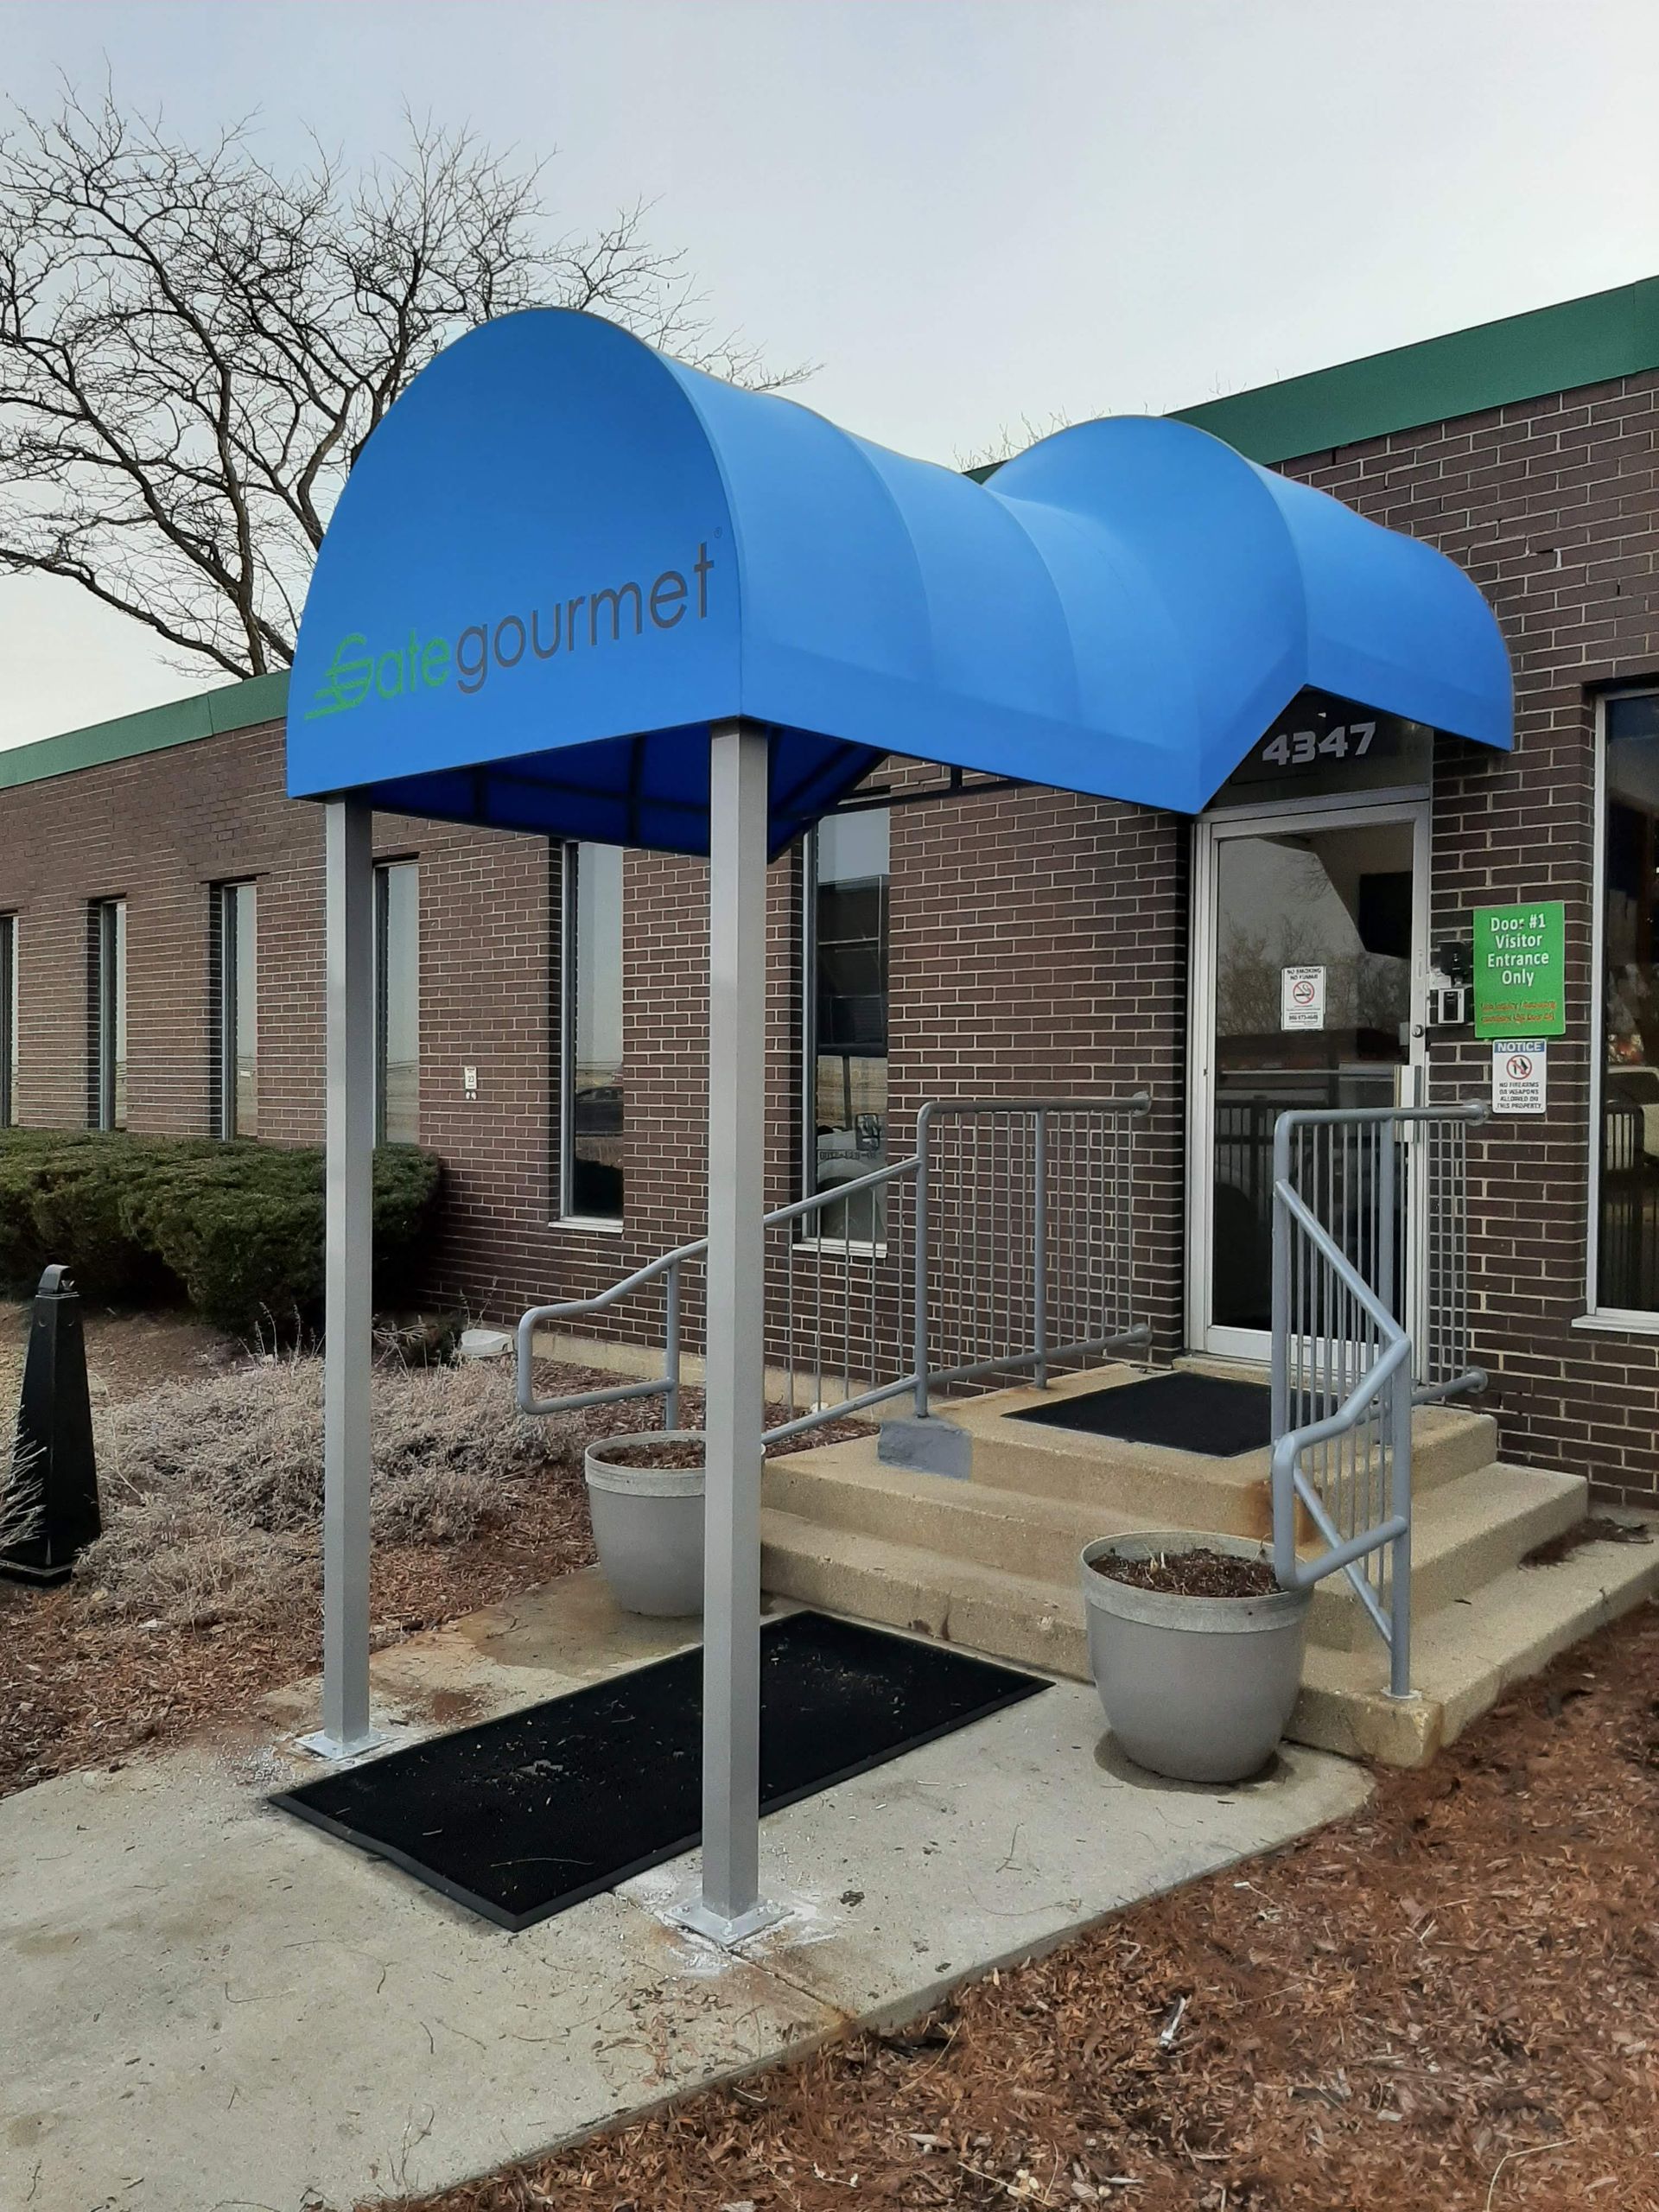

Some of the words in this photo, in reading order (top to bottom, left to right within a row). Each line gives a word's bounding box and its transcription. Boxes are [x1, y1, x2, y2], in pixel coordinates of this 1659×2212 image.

[1262, 721, 1376, 766] 4347
[1491, 917, 1524, 932] Door
[1529, 913, 1546, 930] #1
[1495, 933, 1543, 949] Visitor
[1487, 952, 1549, 968] Entrance
[1502, 969, 1535, 987] Only
[1497, 1041, 1541, 1052] NOTICE
